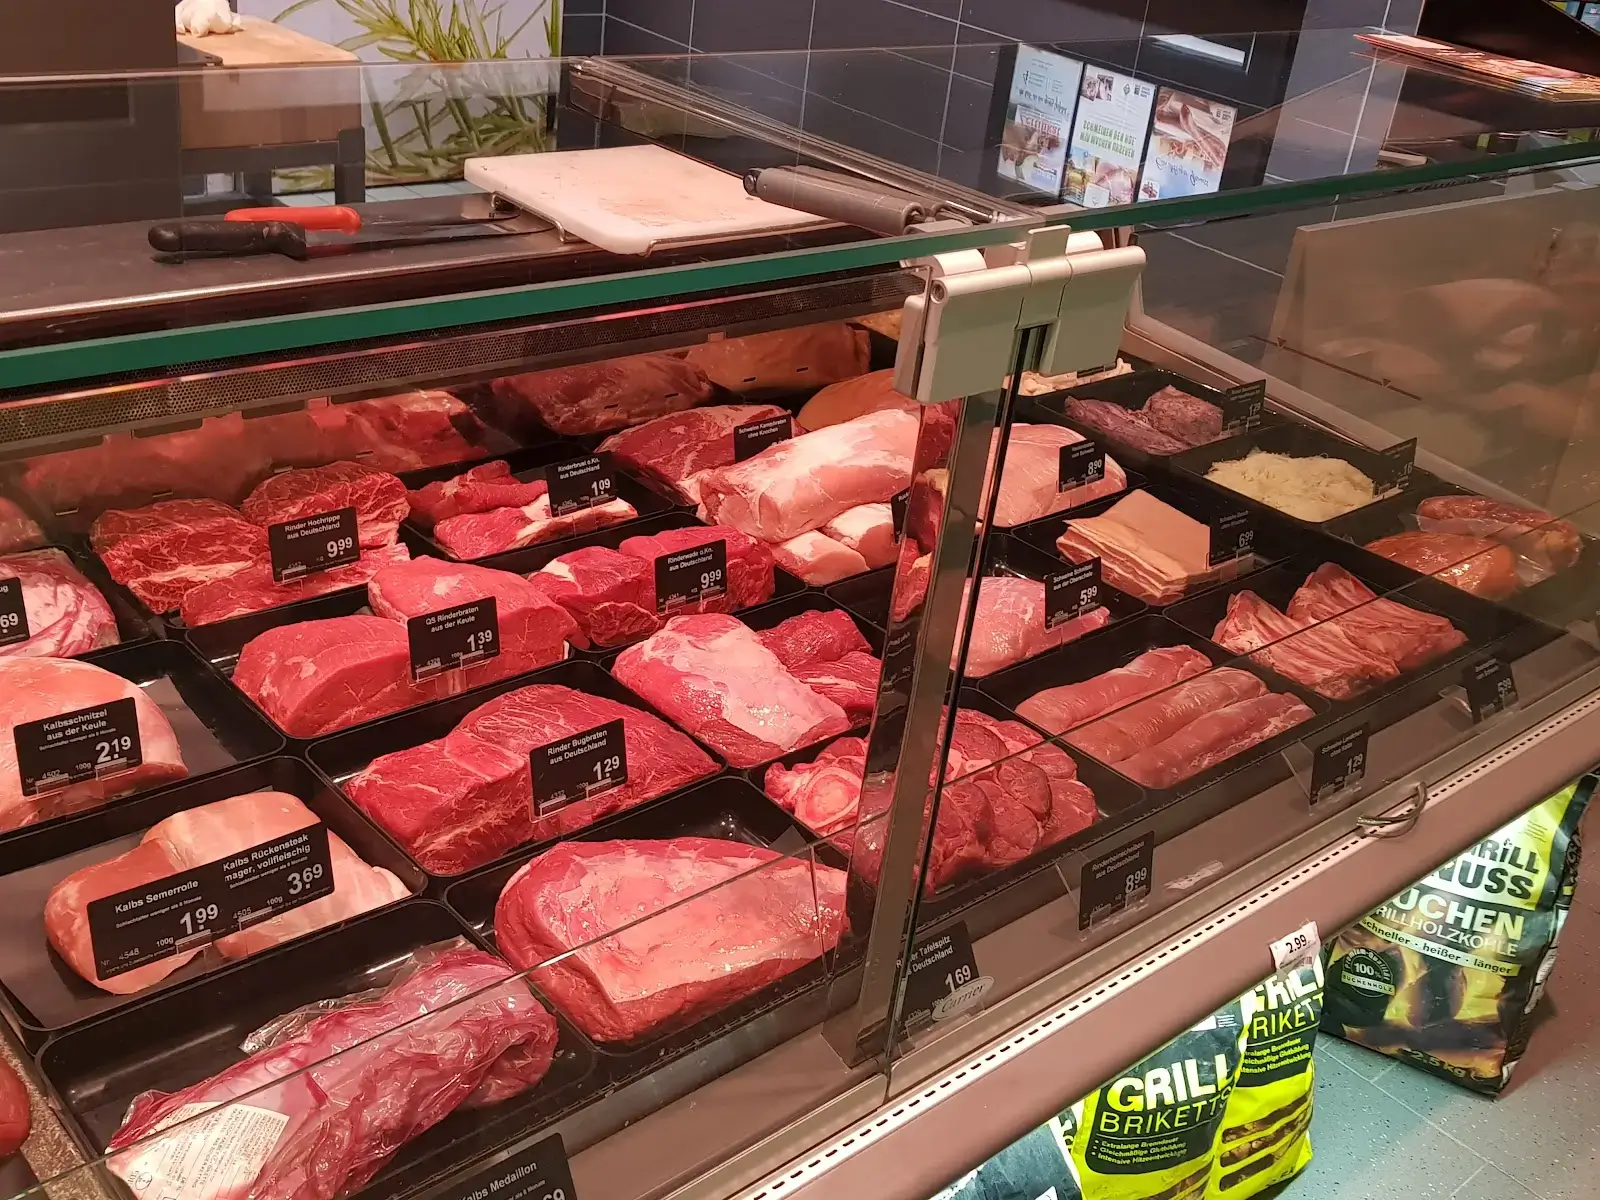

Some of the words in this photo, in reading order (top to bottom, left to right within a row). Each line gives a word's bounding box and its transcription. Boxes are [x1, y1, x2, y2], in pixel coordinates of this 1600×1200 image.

[570, 464, 600, 476] Deutschland
[285, 522, 306, 532] Rinder
[308, 515, 340, 526] Hochrippe
[300, 522, 340, 537] Deutschland
[327, 537, 353, 557] 9.99
[680, 554, 712, 568] Deutschland
[701, 569, 721, 589] 9.99
[1080, 586, 1097, 605] 5.99
[437, 606, 479, 622] Rinderbraten
[445, 620, 455, 629] der
[457, 615, 475, 626] Keule
[467, 629, 493, 651] 1.39
[43, 709, 108, 732] Kalbsschnitzel
[46, 732, 63, 741] aus
[65, 726, 80, 736] der
[81, 720, 107, 731] Keule
[95, 736, 131, 763] 2.19
[547, 743, 571, 756] Rinder
[572, 730, 607, 747] Bugbraten
[550, 756, 563, 765] aus
[564, 739, 606, 759] Deutschland
[593, 755, 620, 780] 1.29
[223, 856, 249, 872] Kalbs
[251, 833, 309, 860] Rückensteak
[257, 844, 310, 869] vollfleischig
[287, 863, 323, 895] 3.69
[1125, 867, 1147, 893] 8.99
[115, 899, 144, 914] Kalbs
[145, 880, 199, 904] Semerrolle
[180, 904, 219, 935] 1.99
[156, 937, 174, 947] 100g
[919, 936, 952, 957] Tafelspitz
[1286, 934, 1306, 953] 2.99
[912, 945, 954, 972] Deutschland
[1422, 942, 1461, 962] heißer
[1473, 958, 1512, 975] länger
[1343, 975, 1393, 992] BUCHENHOLZ
[1107, 1053, 1235, 1112] GRILL
[1100, 1147, 1148, 1157] Gleichmäßige
[1101, 1141, 1139, 1149] Extralange
[1141, 1137, 1179, 1148] Brenndauer
[1098, 1153, 1131, 1164] Intensive
[489, 1162, 537, 1194] Medaillon
